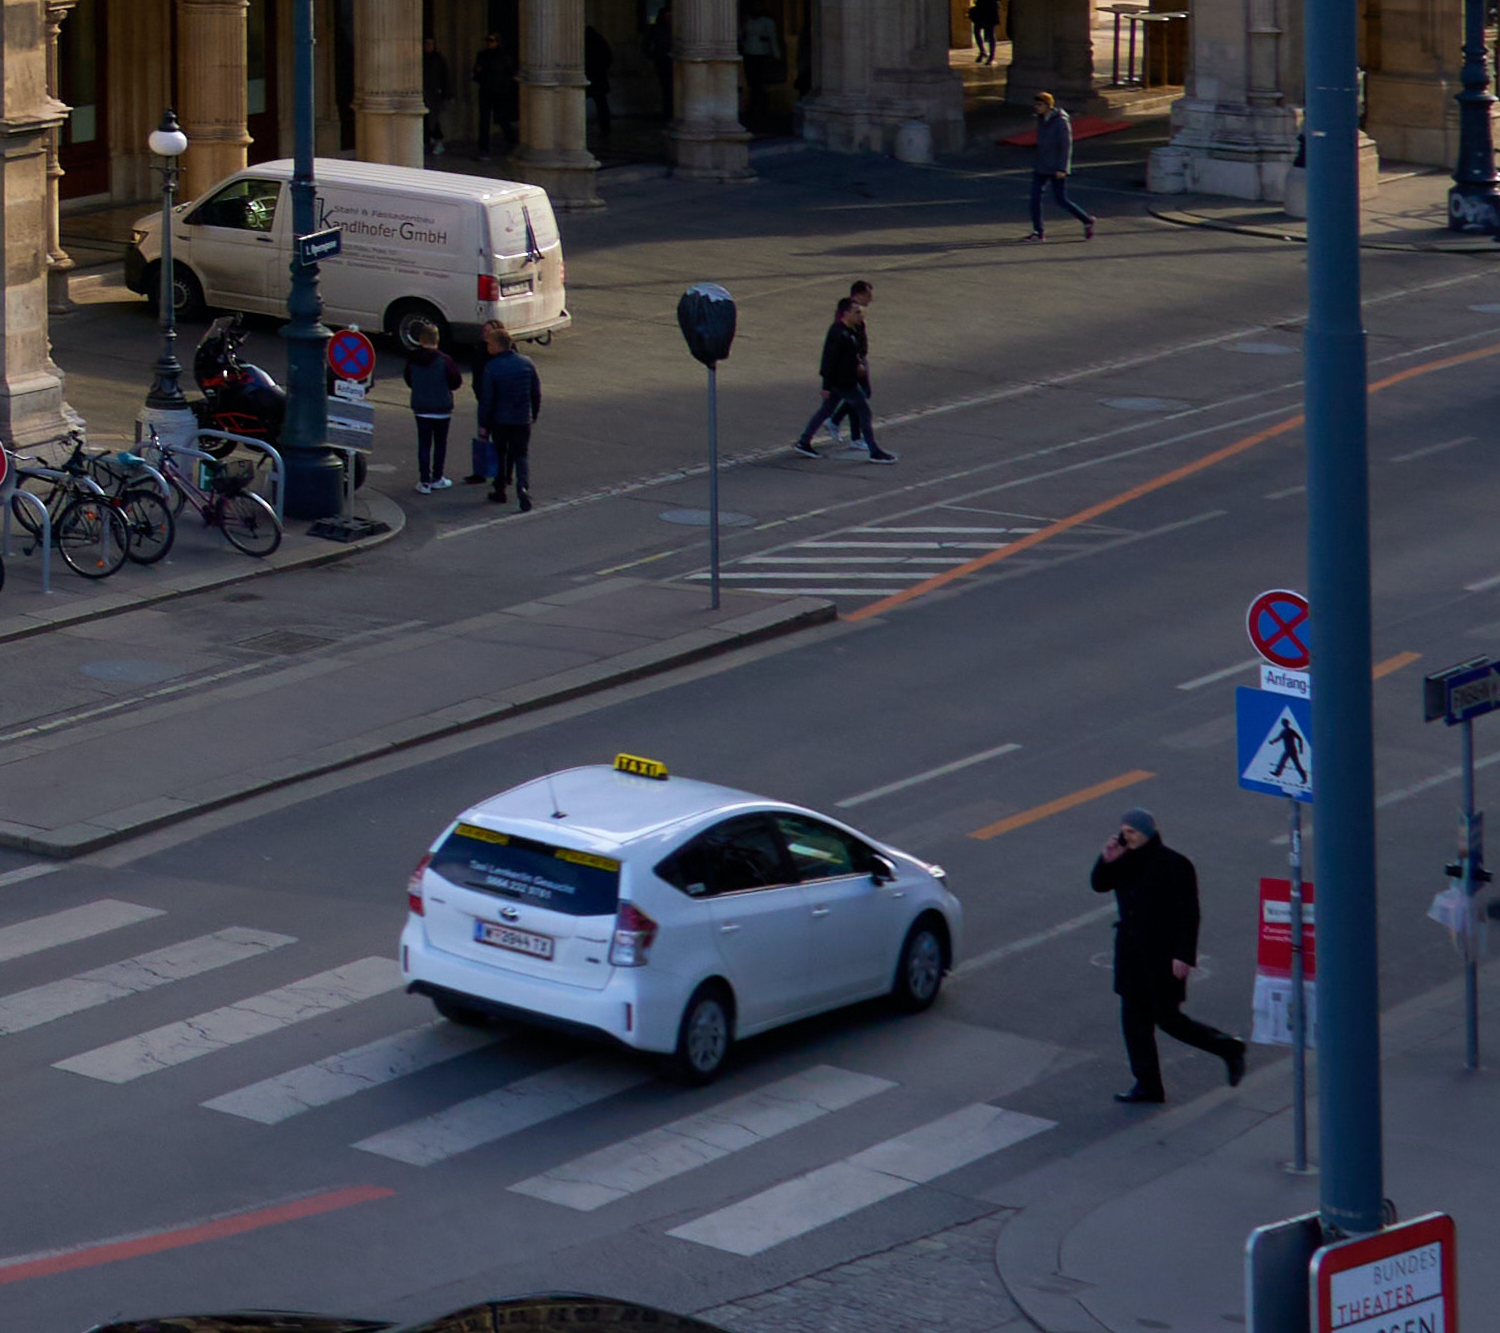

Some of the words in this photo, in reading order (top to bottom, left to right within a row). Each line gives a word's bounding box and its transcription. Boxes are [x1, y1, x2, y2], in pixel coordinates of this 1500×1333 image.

[333, 205, 359, 216] Stahl
[371, 210, 435, 224] Fassadenbau
[399, 222, 447, 245] GmbH
[621, 757, 660, 778] TAXI
[1373, 1248, 1437, 1286] BUNDES
[1337, 1284, 1415, 1325] THEATER
